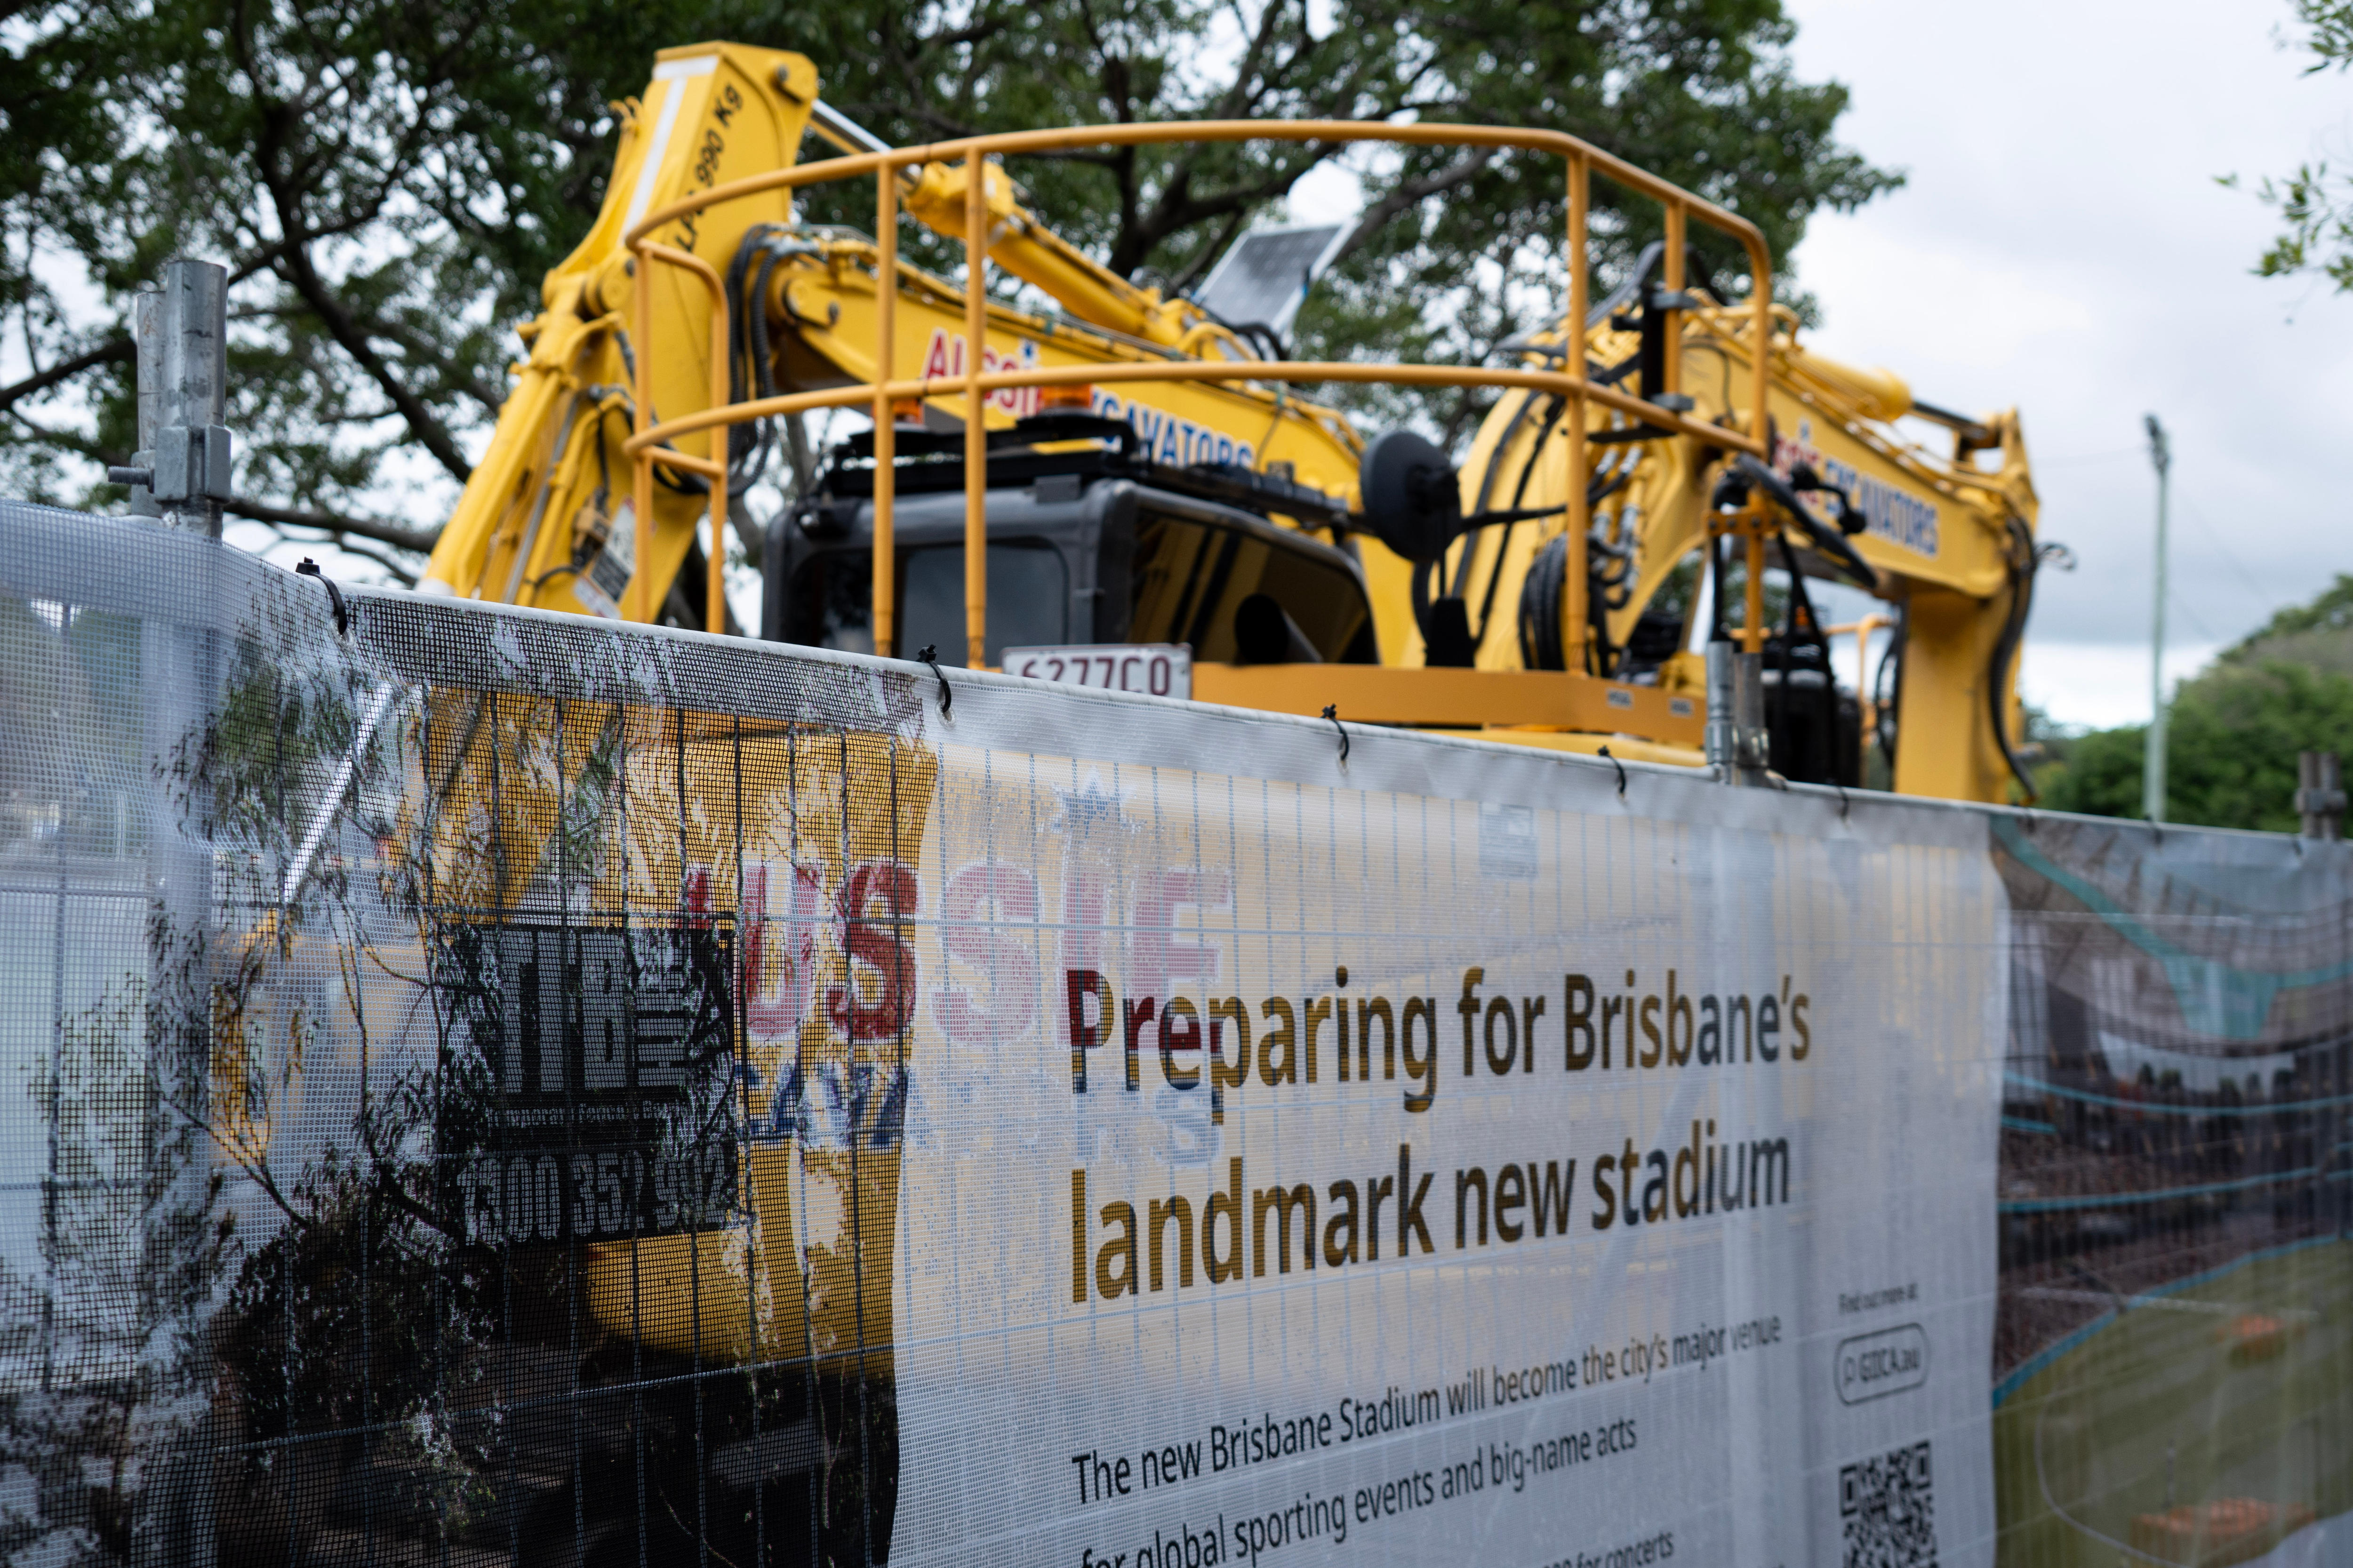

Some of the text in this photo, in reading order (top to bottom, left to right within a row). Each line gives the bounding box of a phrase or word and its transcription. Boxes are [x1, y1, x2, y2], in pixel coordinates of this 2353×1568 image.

[1068, 965, 1437, 1126] Preparing
[1458, 966, 1547, 1078] for
[1072, 1120, 1790, 1303] landmark new stadium
[1072, 1449, 1130, 1504] The
[1141, 1440, 1201, 1489] new
[1210, 1412, 1332, 1472] Brisbane
[1339, 1386, 1439, 1443] Stadium
[1447, 1368, 1485, 1416] will
[1493, 1359, 1577, 1406] become
[1582, 1344, 1615, 1386] the
[1673, 1323, 1725, 1371] major
[1730, 1316, 1782, 1352] venue
[1234, 1492, 1346, 1568] sporting
[1355, 1469, 1435, 1523] events
[1441, 1446, 1483, 1500] and
[1490, 1431, 1592, 1493] big-name
[1596, 1416, 1637, 1457] acts
